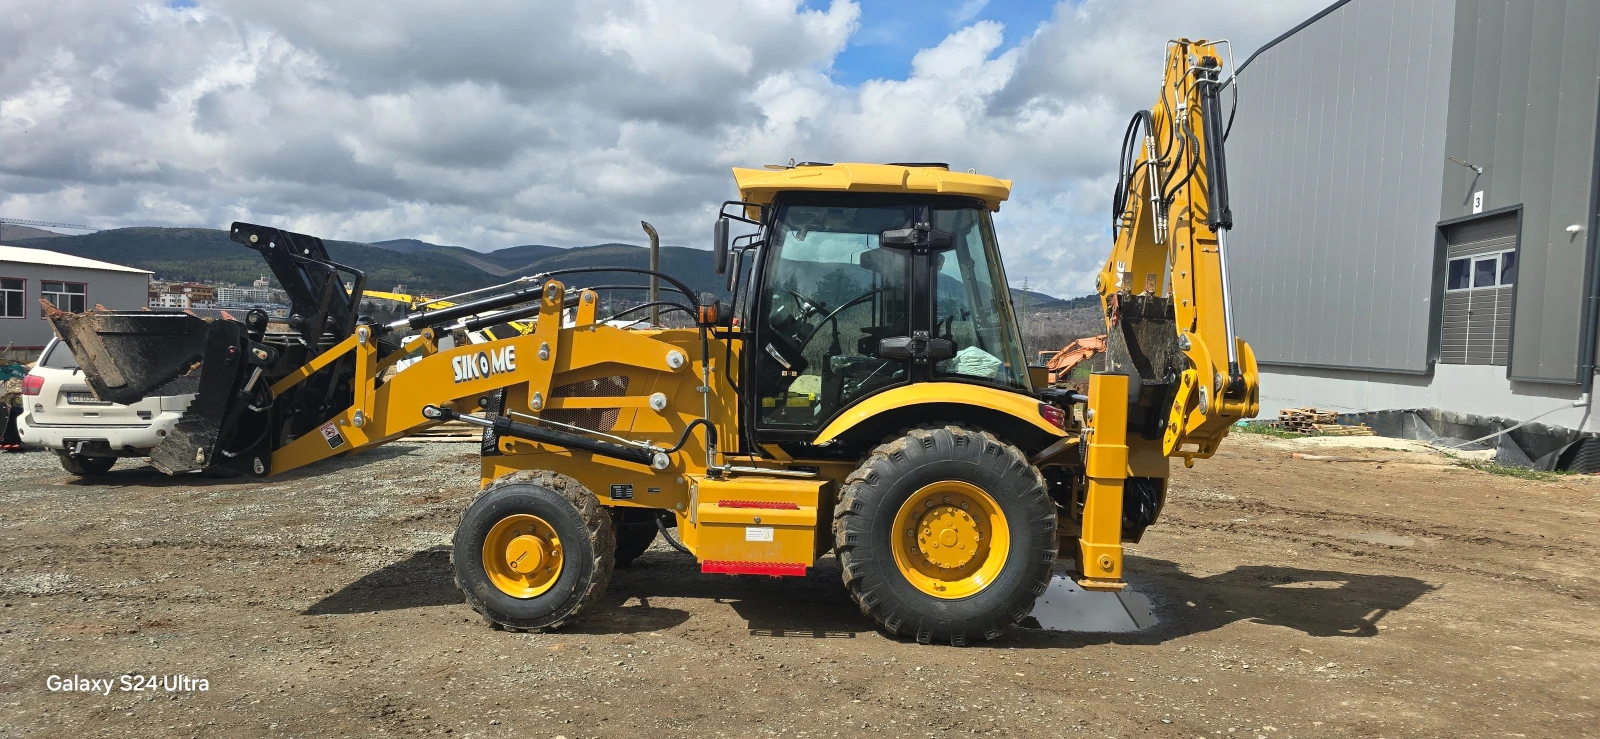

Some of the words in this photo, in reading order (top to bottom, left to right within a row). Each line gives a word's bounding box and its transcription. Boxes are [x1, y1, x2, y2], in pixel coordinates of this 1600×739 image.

[1475, 197, 1480, 207] 3
[451, 345, 516, 383] SIKOME
[73, 393, 82, 402] CT
